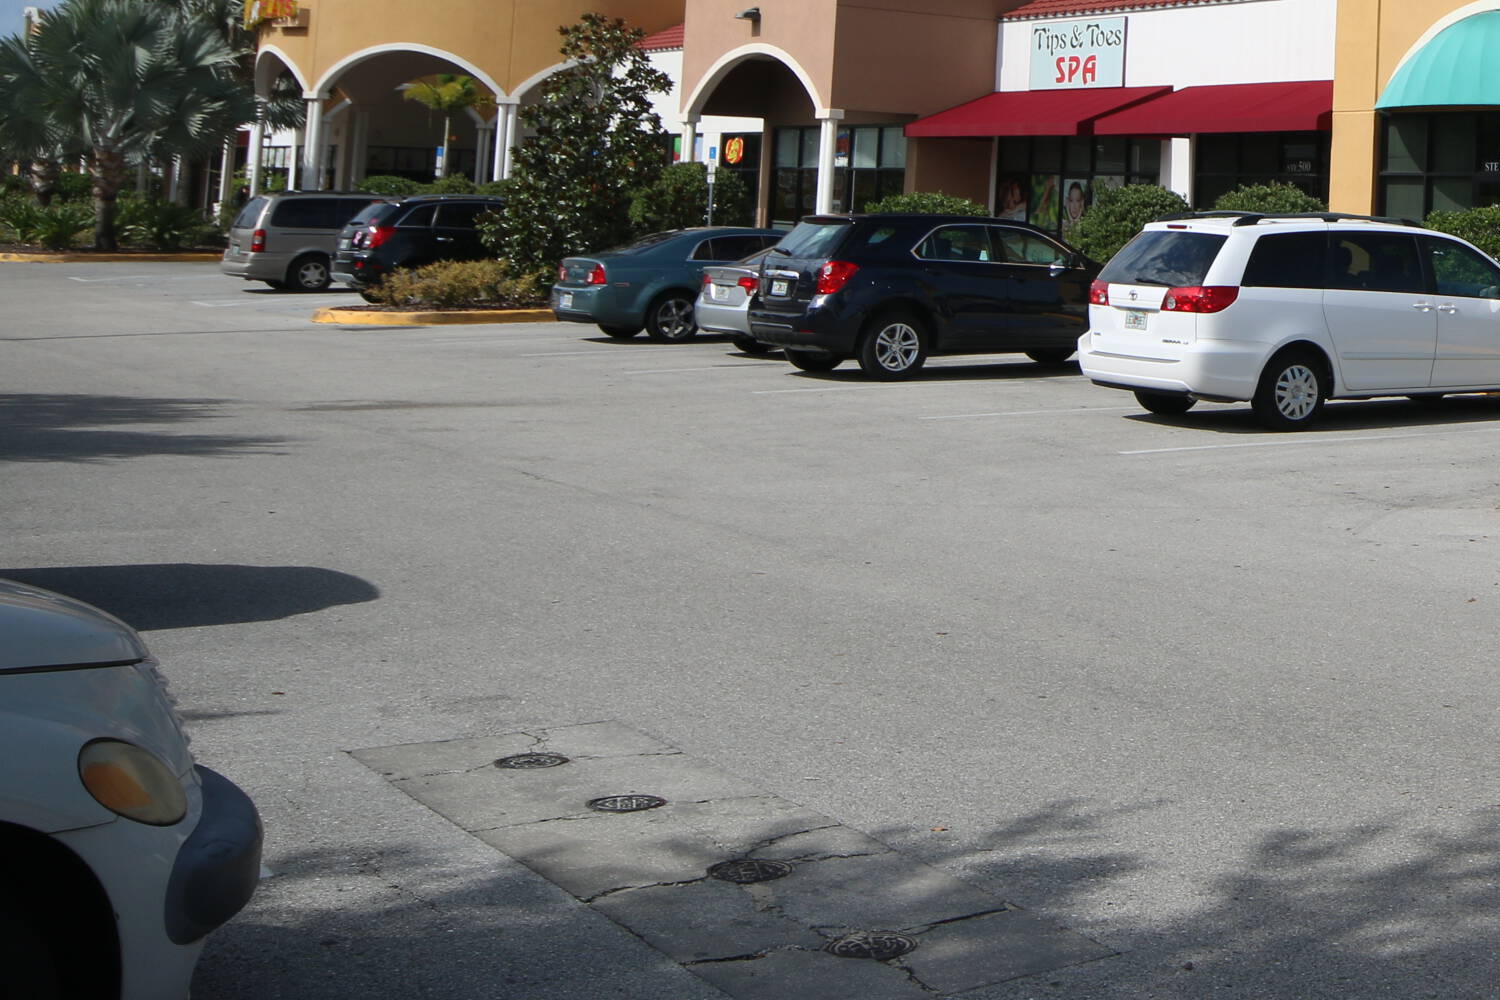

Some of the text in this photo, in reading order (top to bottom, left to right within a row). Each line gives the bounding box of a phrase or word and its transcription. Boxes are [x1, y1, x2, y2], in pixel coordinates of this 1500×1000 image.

[1034, 23, 1122, 56] Tips & Toes
[1055, 55, 1096, 85] SPA
[1485, 162, 1499, 172] STE
